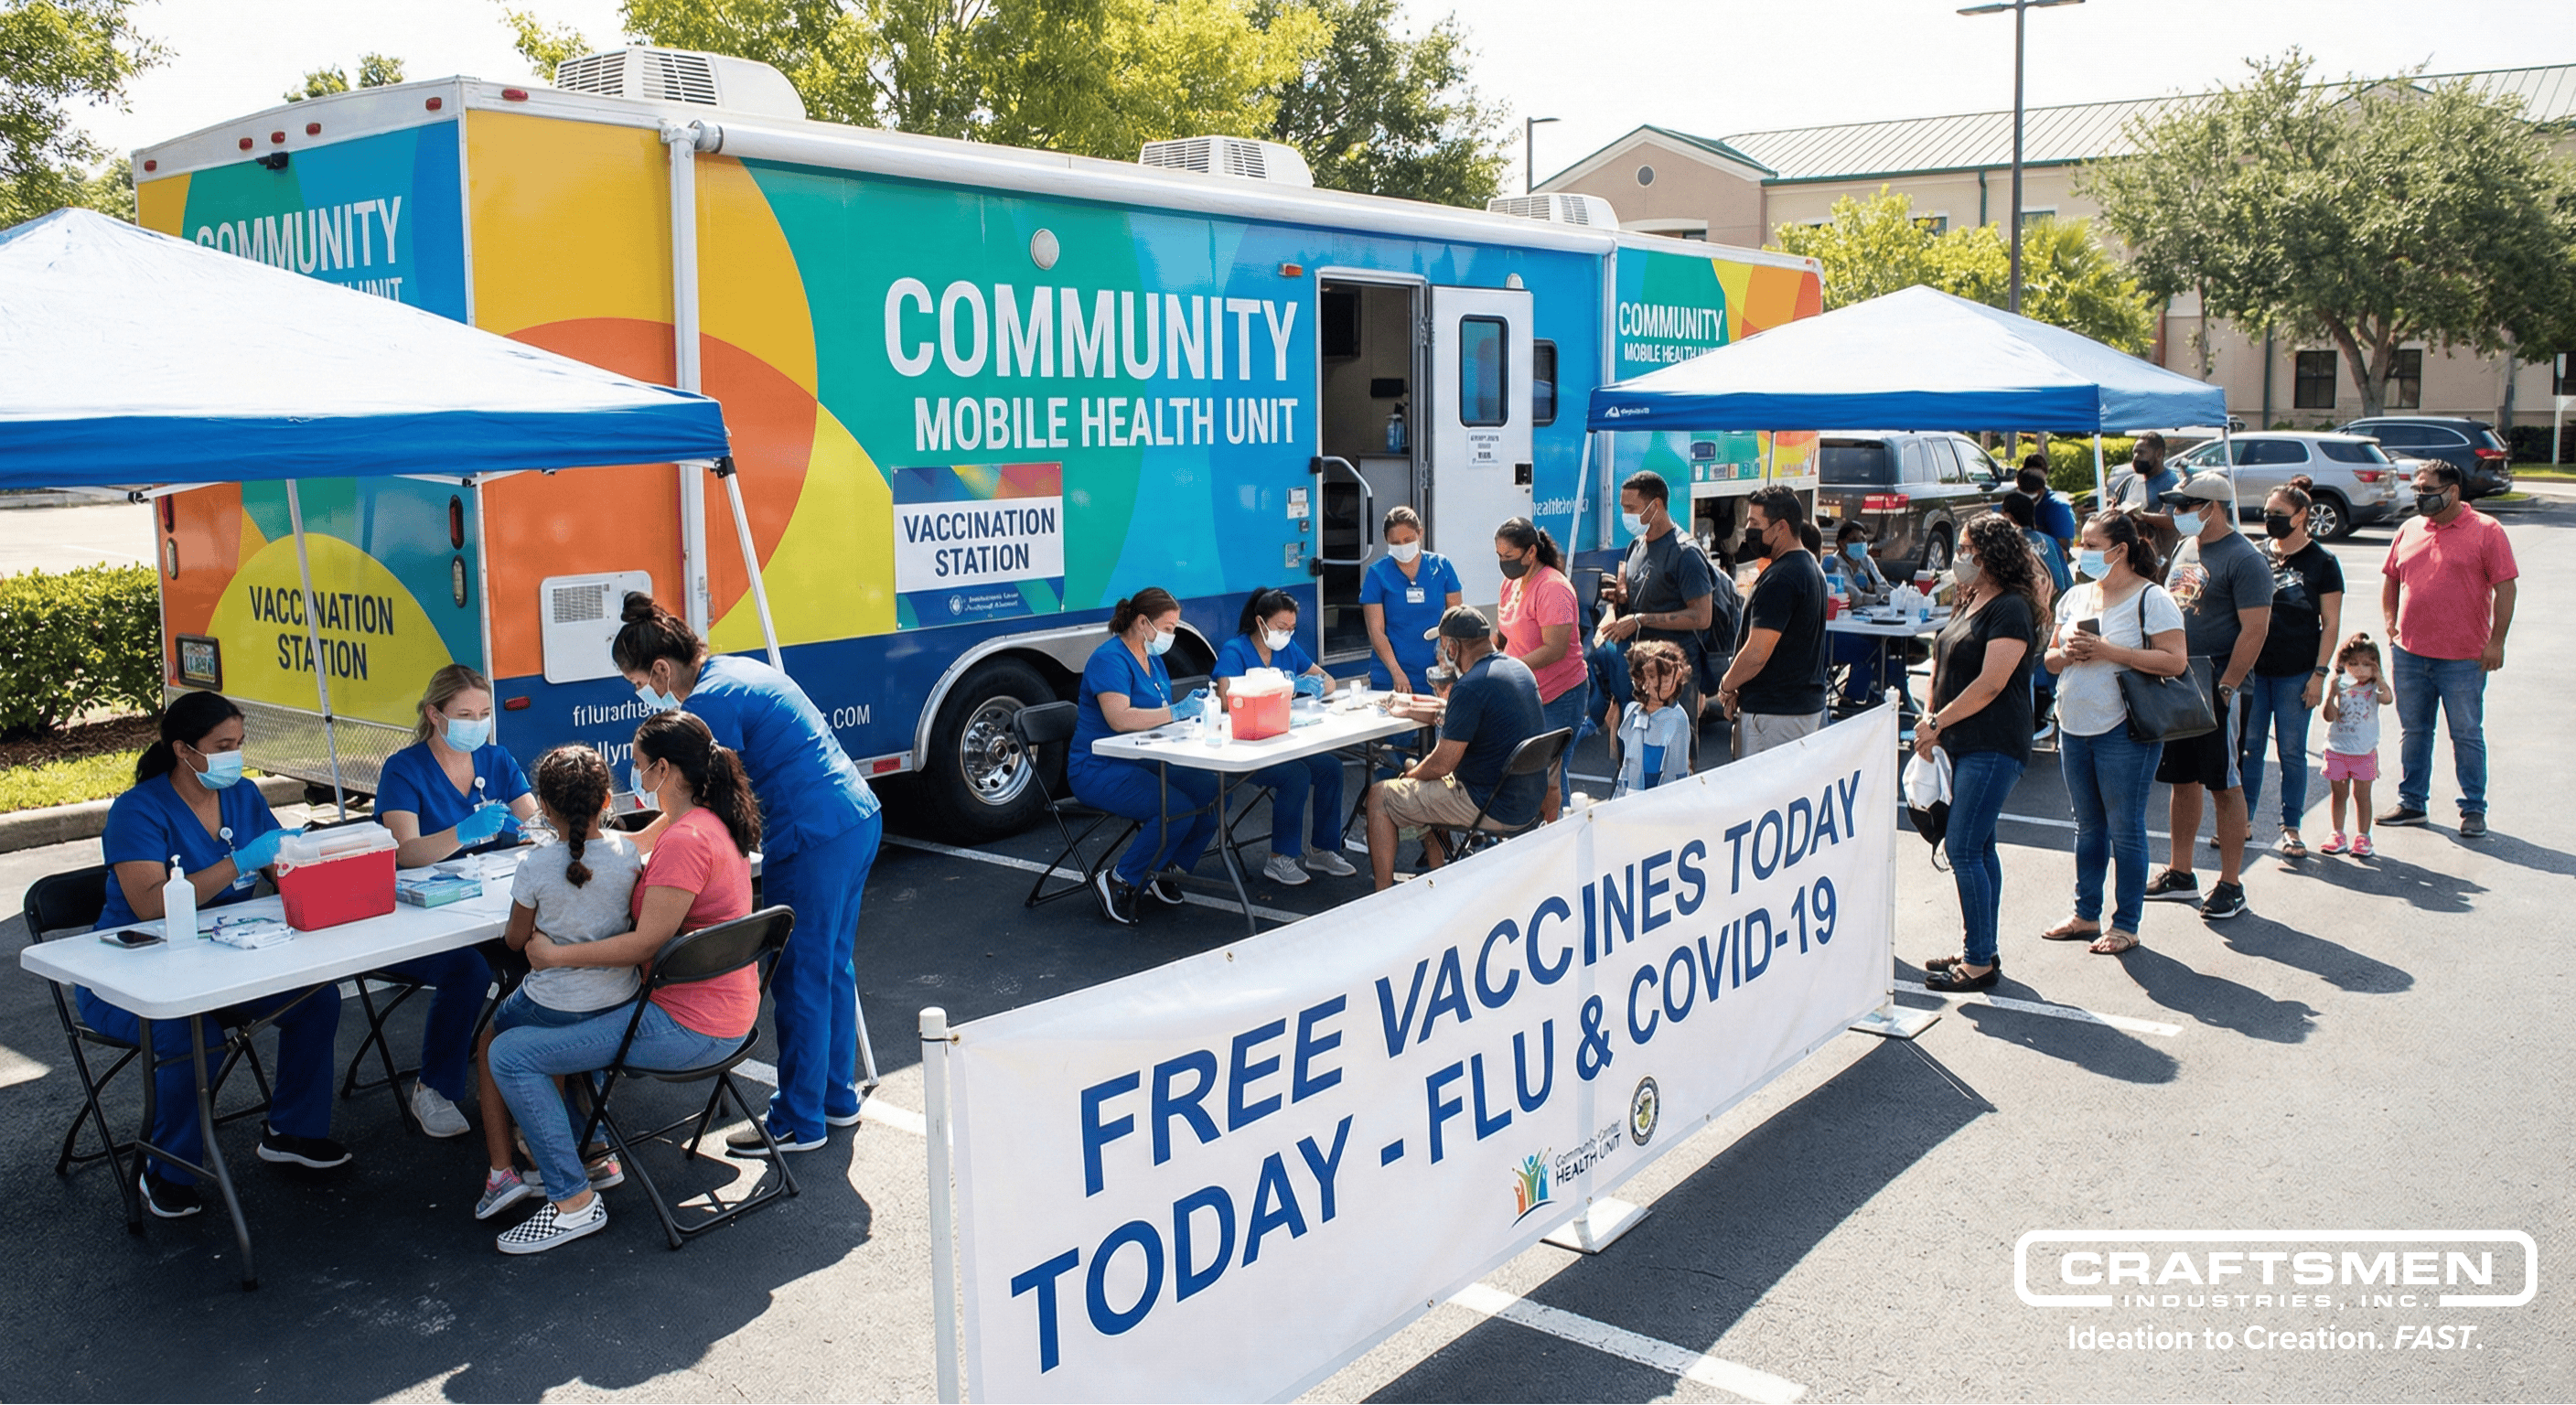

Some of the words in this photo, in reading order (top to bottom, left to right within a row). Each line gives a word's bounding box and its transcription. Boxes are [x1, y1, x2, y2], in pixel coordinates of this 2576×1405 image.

[196, 195, 402, 274] MMUNITY
[885, 277, 1298, 381] COMMUNITY
[1618, 301, 1723, 341] COMMUNITY
[1624, 342, 1660, 362] MOBILE
[915, 397, 1068, 451] MOBILE
[1081, 397, 1214, 447] HEALTH
[1226, 398, 1298, 445] UNIT
[903, 507, 1056, 543] VACCINATION
[935, 542, 1030, 578] STATION
[248, 585, 394, 636] VACCINATION
[277, 633, 368, 681] STATION
[1079, 993, 1347, 1197] FREE
[1375, 839, 1707, 1058] VACCINES
[1725, 770, 1862, 894] TODAY
[1011, 1115, 1354, 1374] TODAY
[1380, 1140, 1404, 1166] -
[1426, 1018, 1555, 1165] FLU
[1575, 994, 1615, 1082] &
[1627, 875, 1838, 1046] COVID-19
[1556, 1150, 1598, 1187] HEALTH
[1599, 1132, 1622, 1160] UNIT
